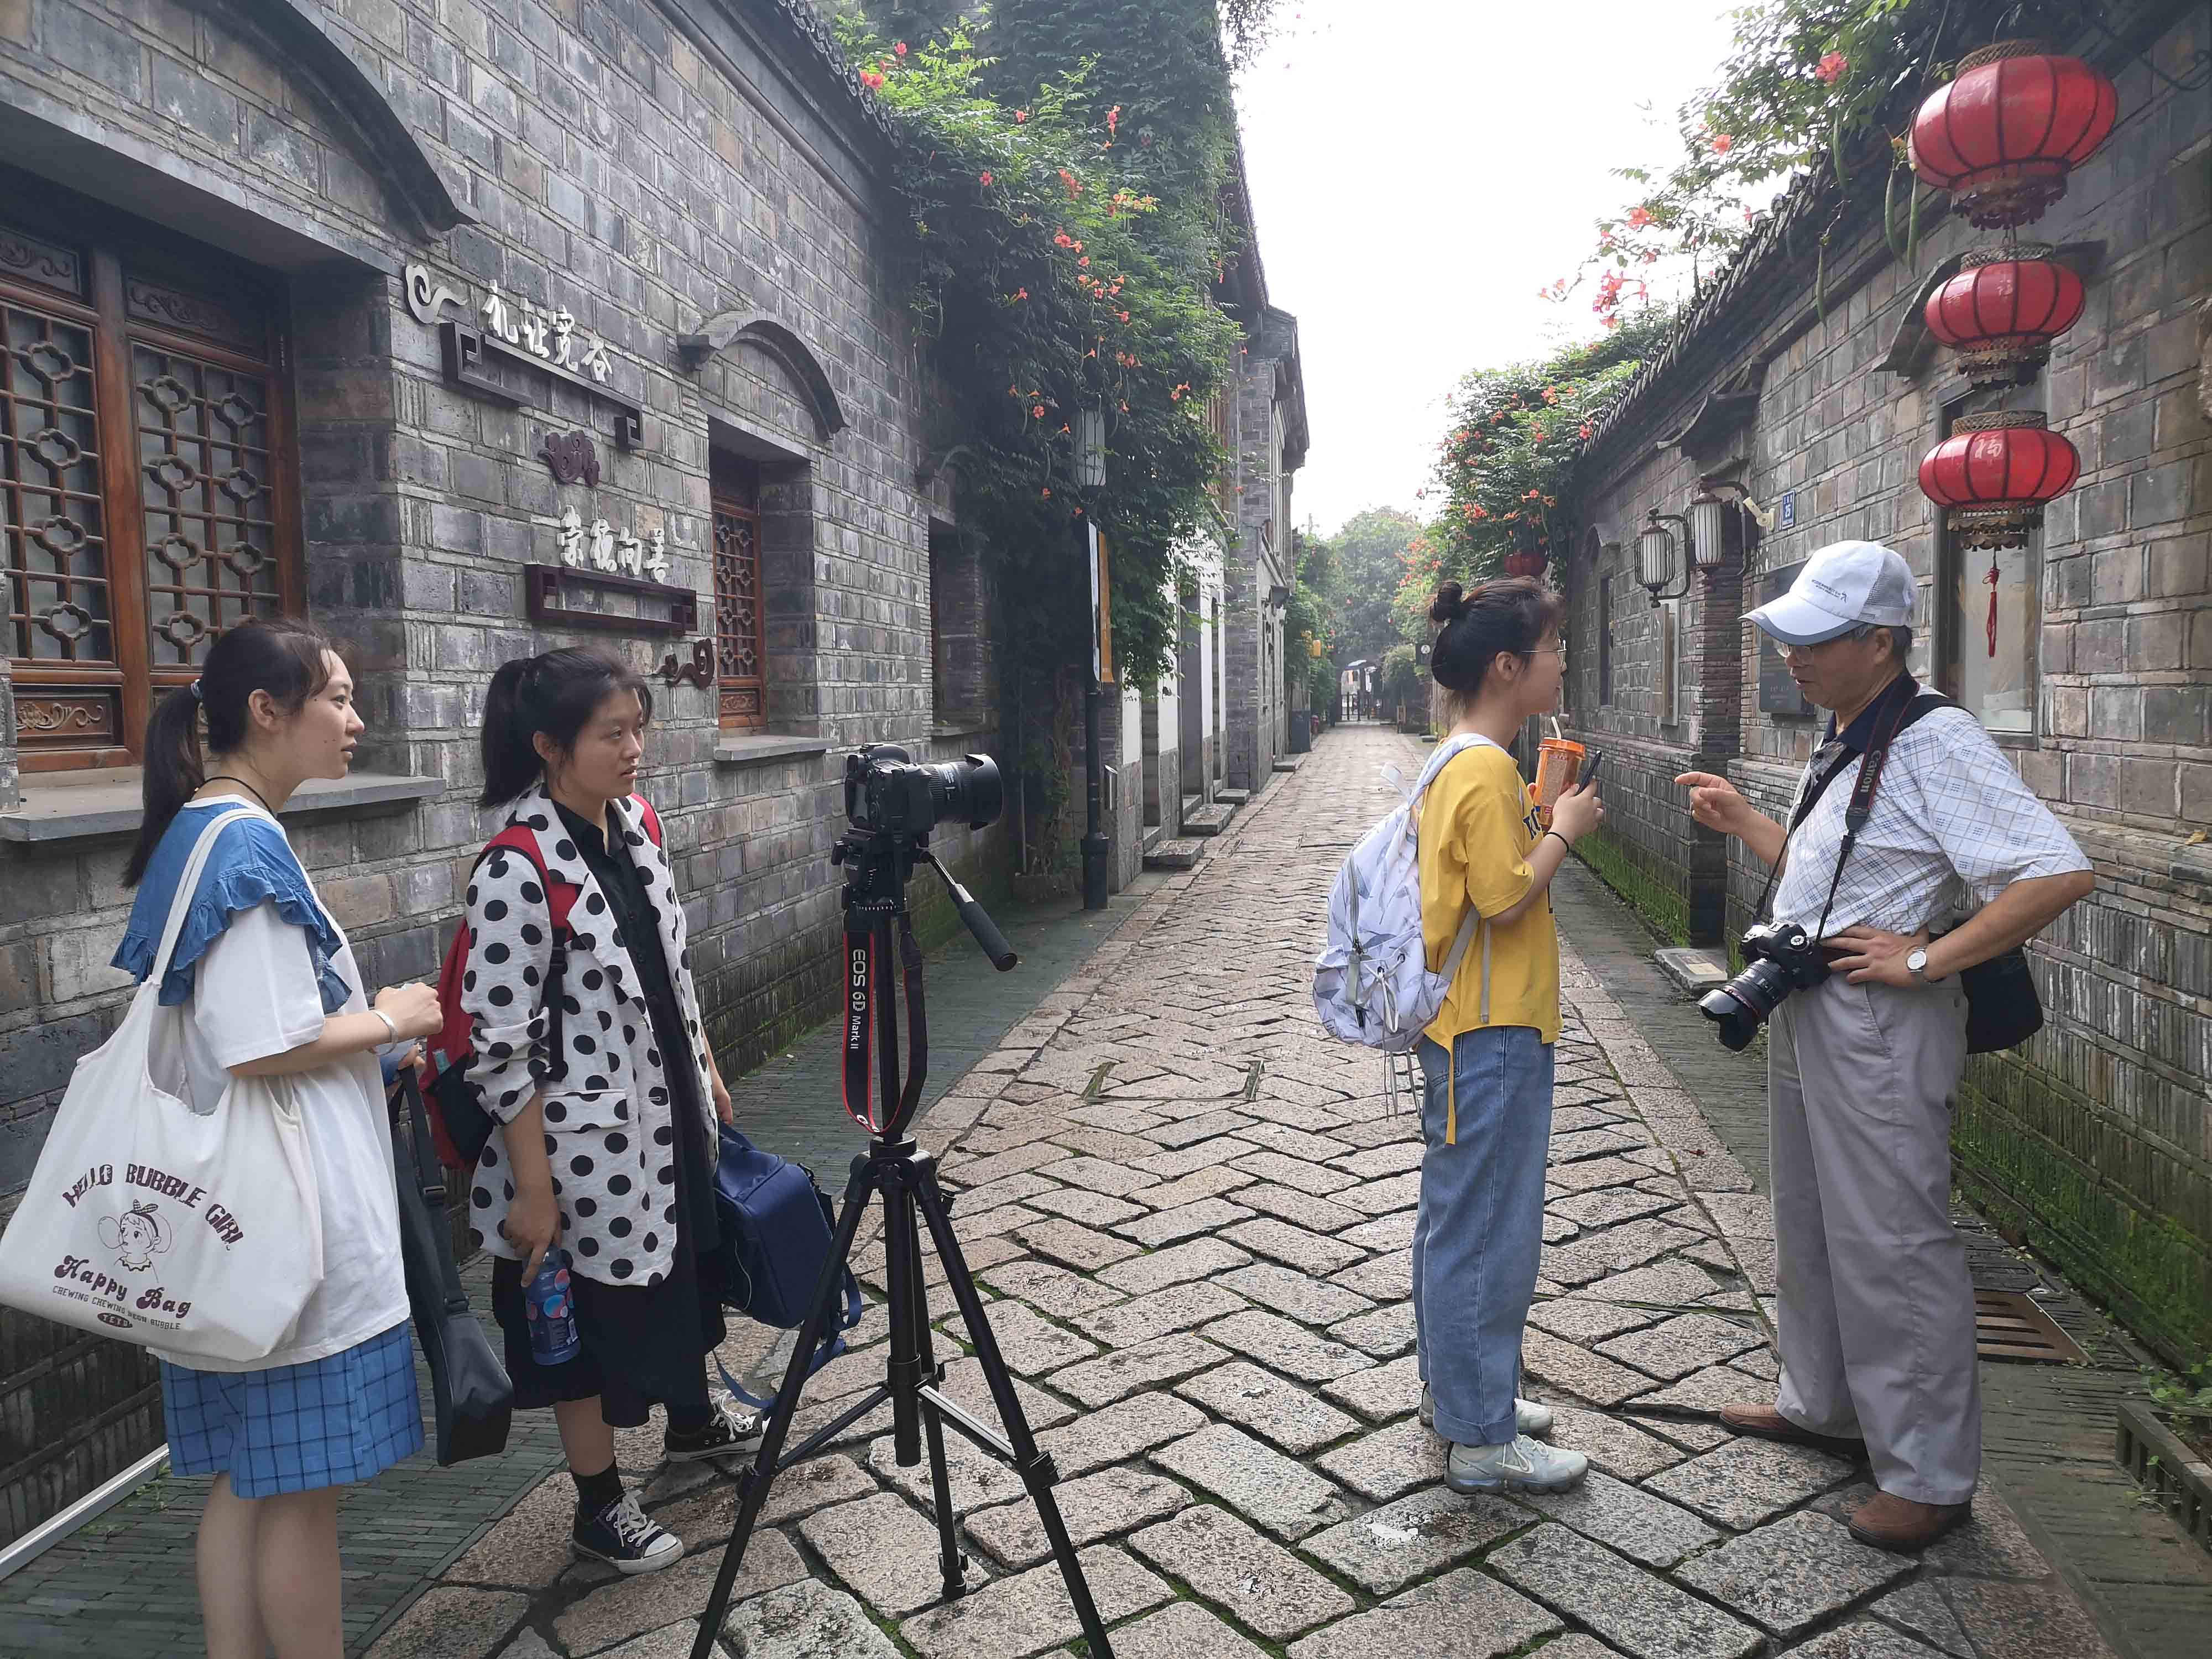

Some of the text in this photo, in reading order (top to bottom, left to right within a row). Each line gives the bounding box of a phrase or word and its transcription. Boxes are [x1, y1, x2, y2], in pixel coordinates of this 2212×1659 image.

[557, 505, 669, 584] 崇德向善
[1860, 750, 1882, 793] Canon
[853, 949, 866, 987] EOS
[852, 992, 865, 1011] 6D
[851, 1015, 862, 1041] Mark
[125, 1163, 207, 1208] BUBBLE
[53, 1285, 88, 1302] CHEWING
[92, 1297, 126, 1314] CHEWING
[54, 1255, 191, 1318] Happy Bag
